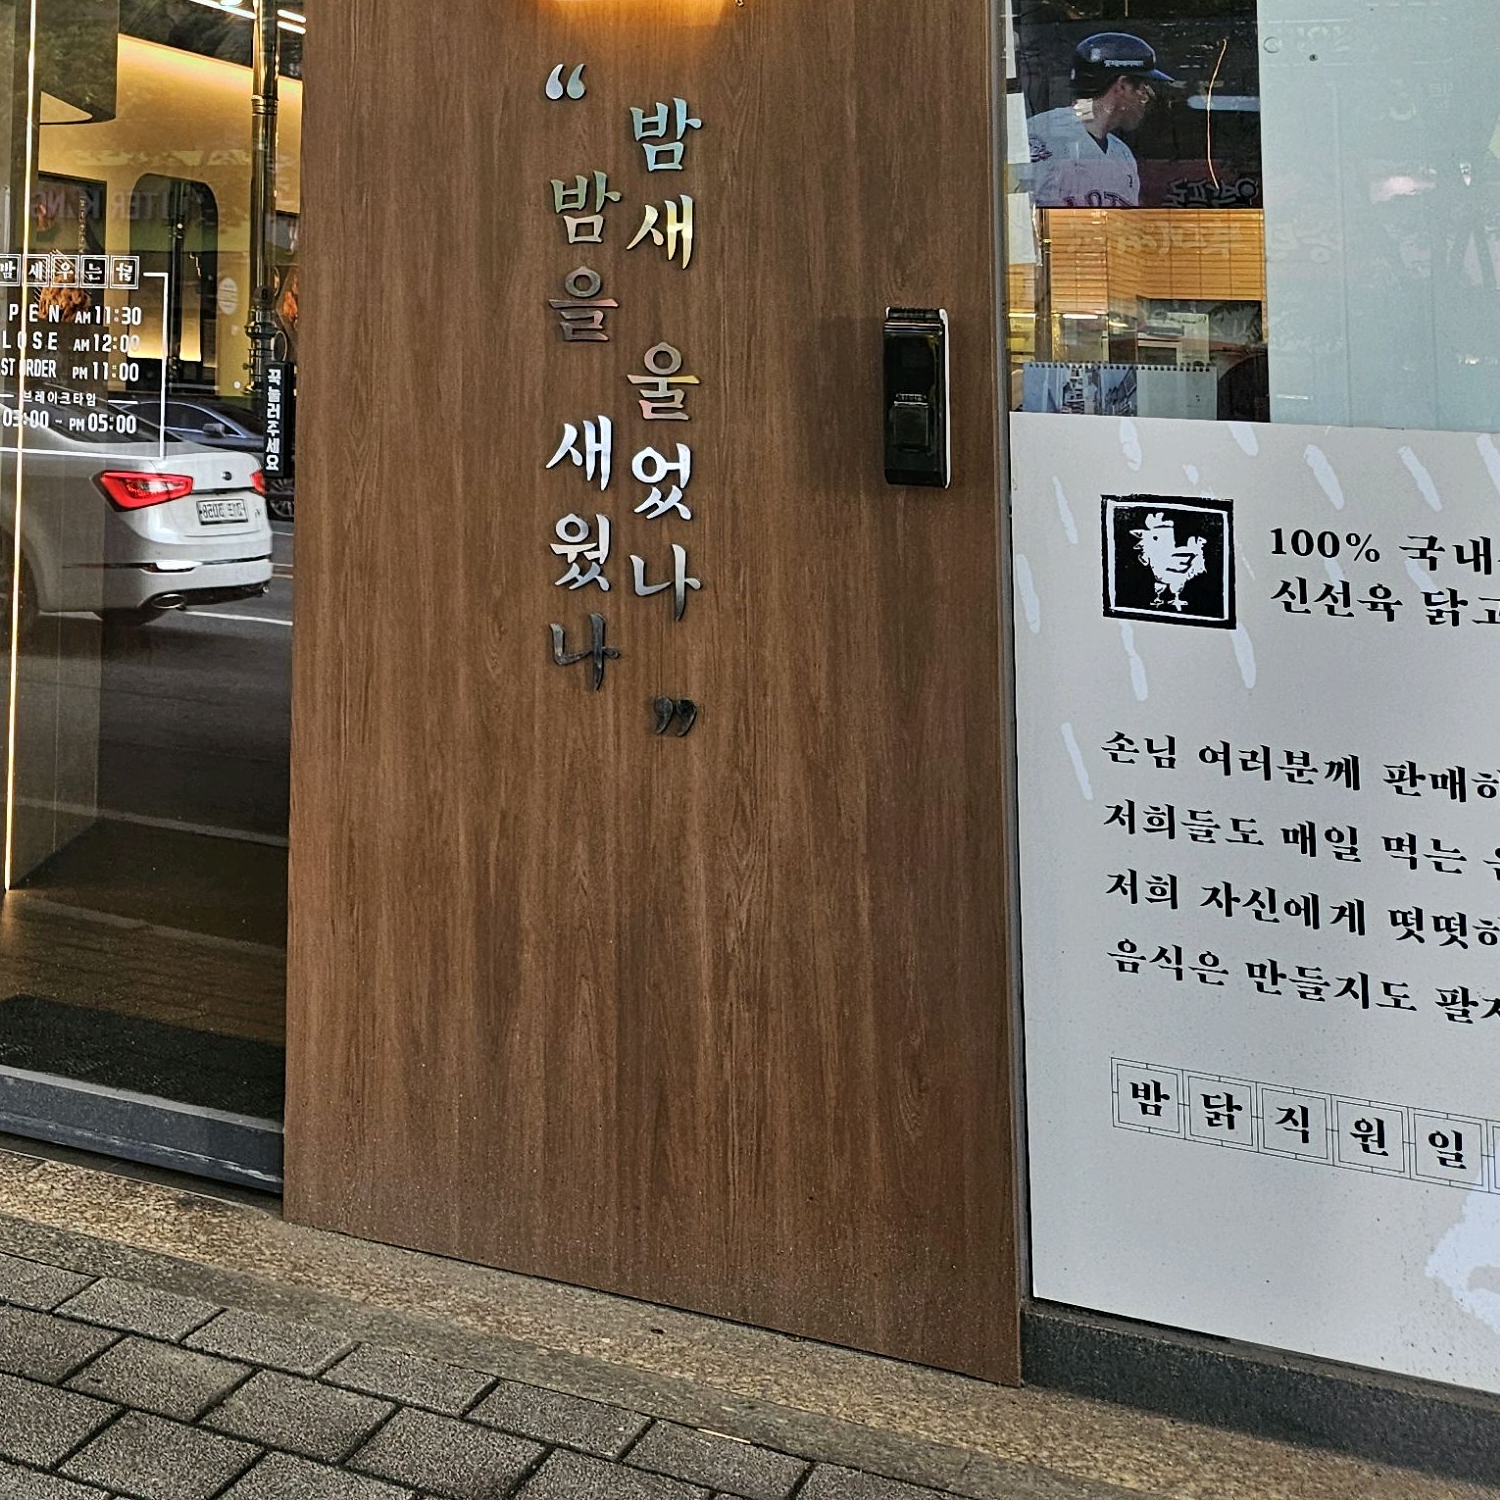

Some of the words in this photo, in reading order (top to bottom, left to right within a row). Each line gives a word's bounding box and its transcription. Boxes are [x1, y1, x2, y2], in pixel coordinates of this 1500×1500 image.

[626, 97, 703, 270] 밤새
[548, 170, 622, 342] 밤을
[95, 306, 142, 326] 11:30
[22, 391, 97, 407] 브레이크타임
[93, 361, 140, 382] 11:00
[87, 412, 138, 434] 05:00
[626, 341, 703, 622] 울었나
[545, 415, 621, 691] 새웠나
[1270, 528, 1381, 563] 100%
[1399, 535, 1500, 575] 국내
[1270, 576, 1404, 622] 신선육
[1101, 731, 1177, 770] 손님
[1199, 740, 1361, 791] 여러분께
[1103, 799, 1265, 847] 저희들도
[1280, 819, 1362, 863] 매일
[1381, 831, 1467, 874] 먹는
[1105, 869, 1178, 909] 저희
[1199, 881, 1366, 936] 자신에게
[1107, 937, 1229, 987] 음식은
[1245, 958, 1417, 1013] 만들지도
